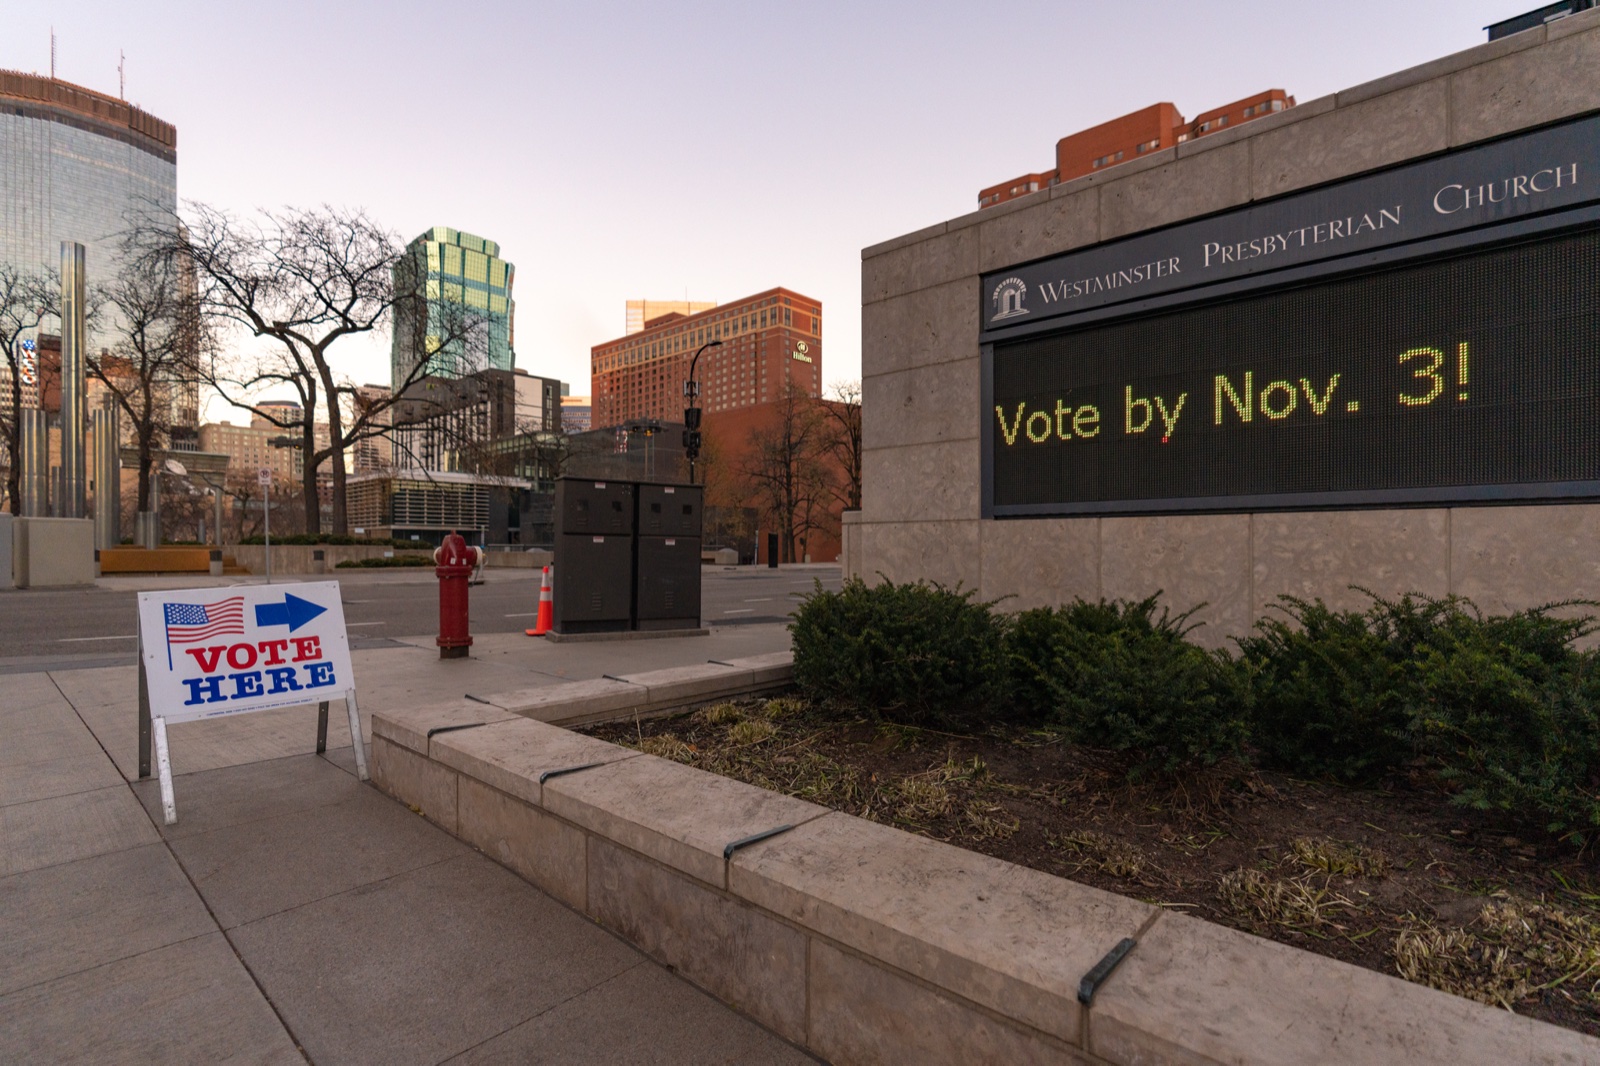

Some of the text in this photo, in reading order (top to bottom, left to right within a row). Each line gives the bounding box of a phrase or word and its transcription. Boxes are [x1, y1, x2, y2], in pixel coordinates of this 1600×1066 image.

[1038, 163, 1578, 304] WESTMINSTER PRESBYTERIAN CHURCH
[792, 351, 812, 363] Hilton
[995, 341, 1469, 446] Vote by Nov. 3!
[185, 635, 322, 673] VOTE
[182, 661, 336, 706] HERE
